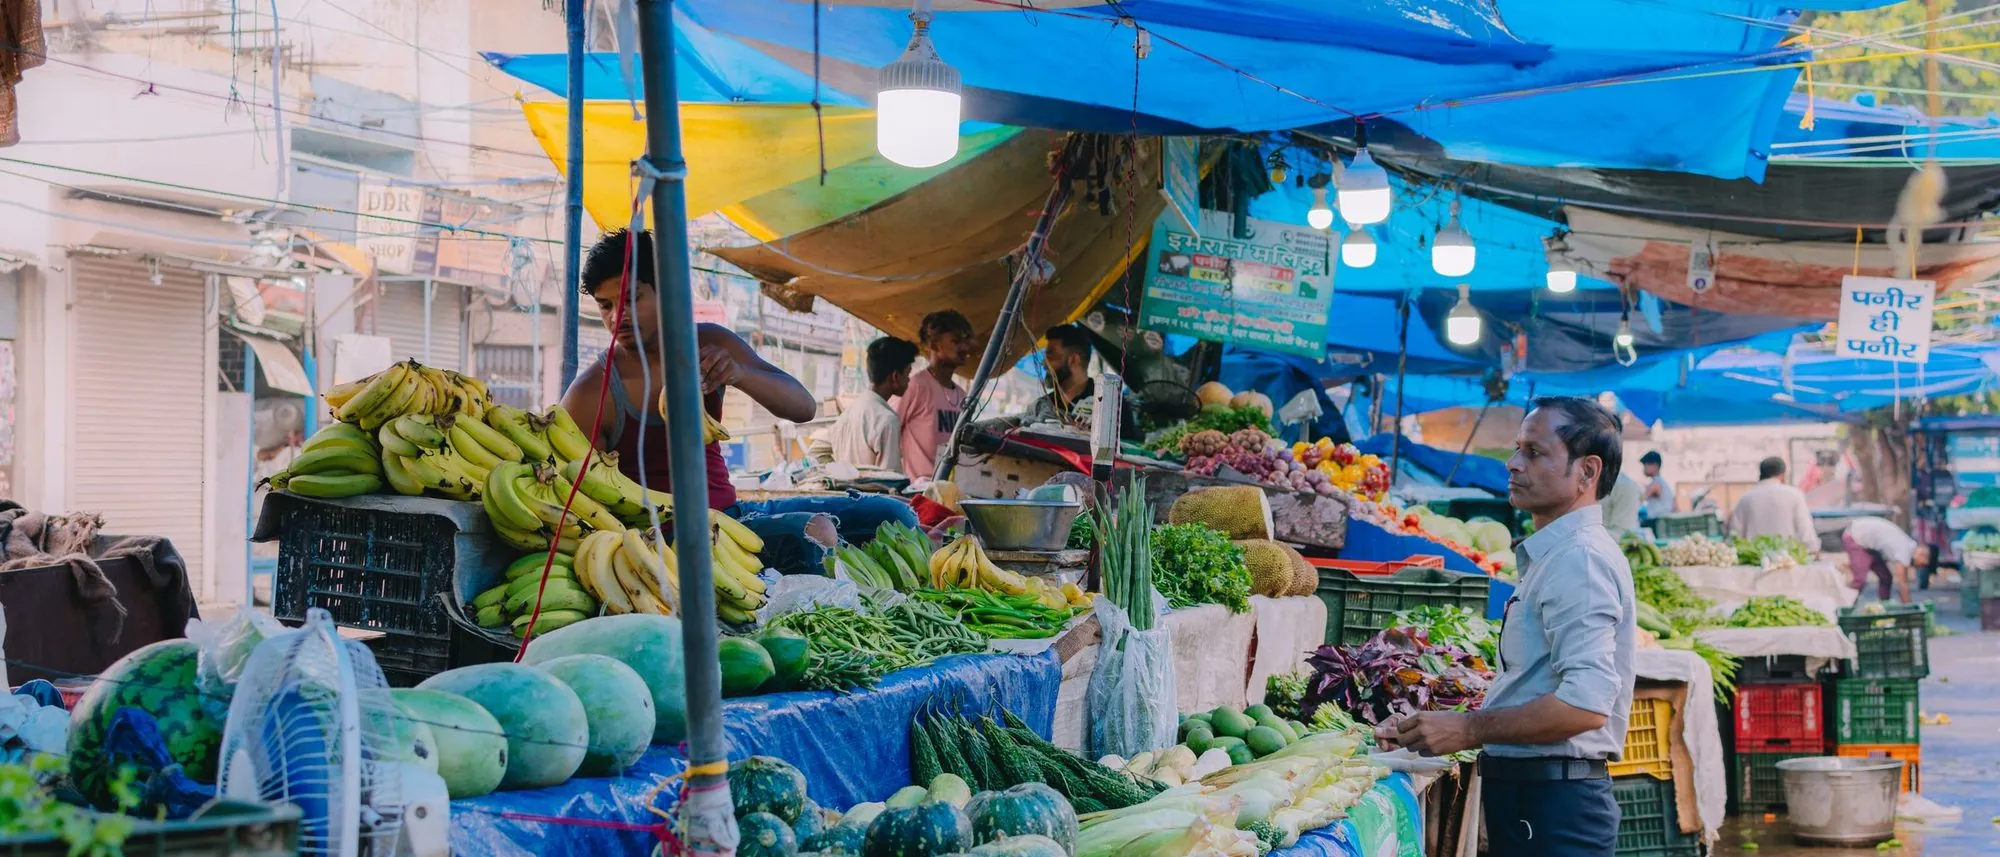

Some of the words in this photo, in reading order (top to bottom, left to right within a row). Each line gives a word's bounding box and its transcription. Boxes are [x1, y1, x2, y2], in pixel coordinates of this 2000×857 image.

[367, 191, 411, 213] DDR
[368, 243, 405, 257] SHOP
[1851, 287, 1924, 310] पनीर
[1869, 310, 1901, 332] ही
[1847, 335, 1919, 358] पनीर
